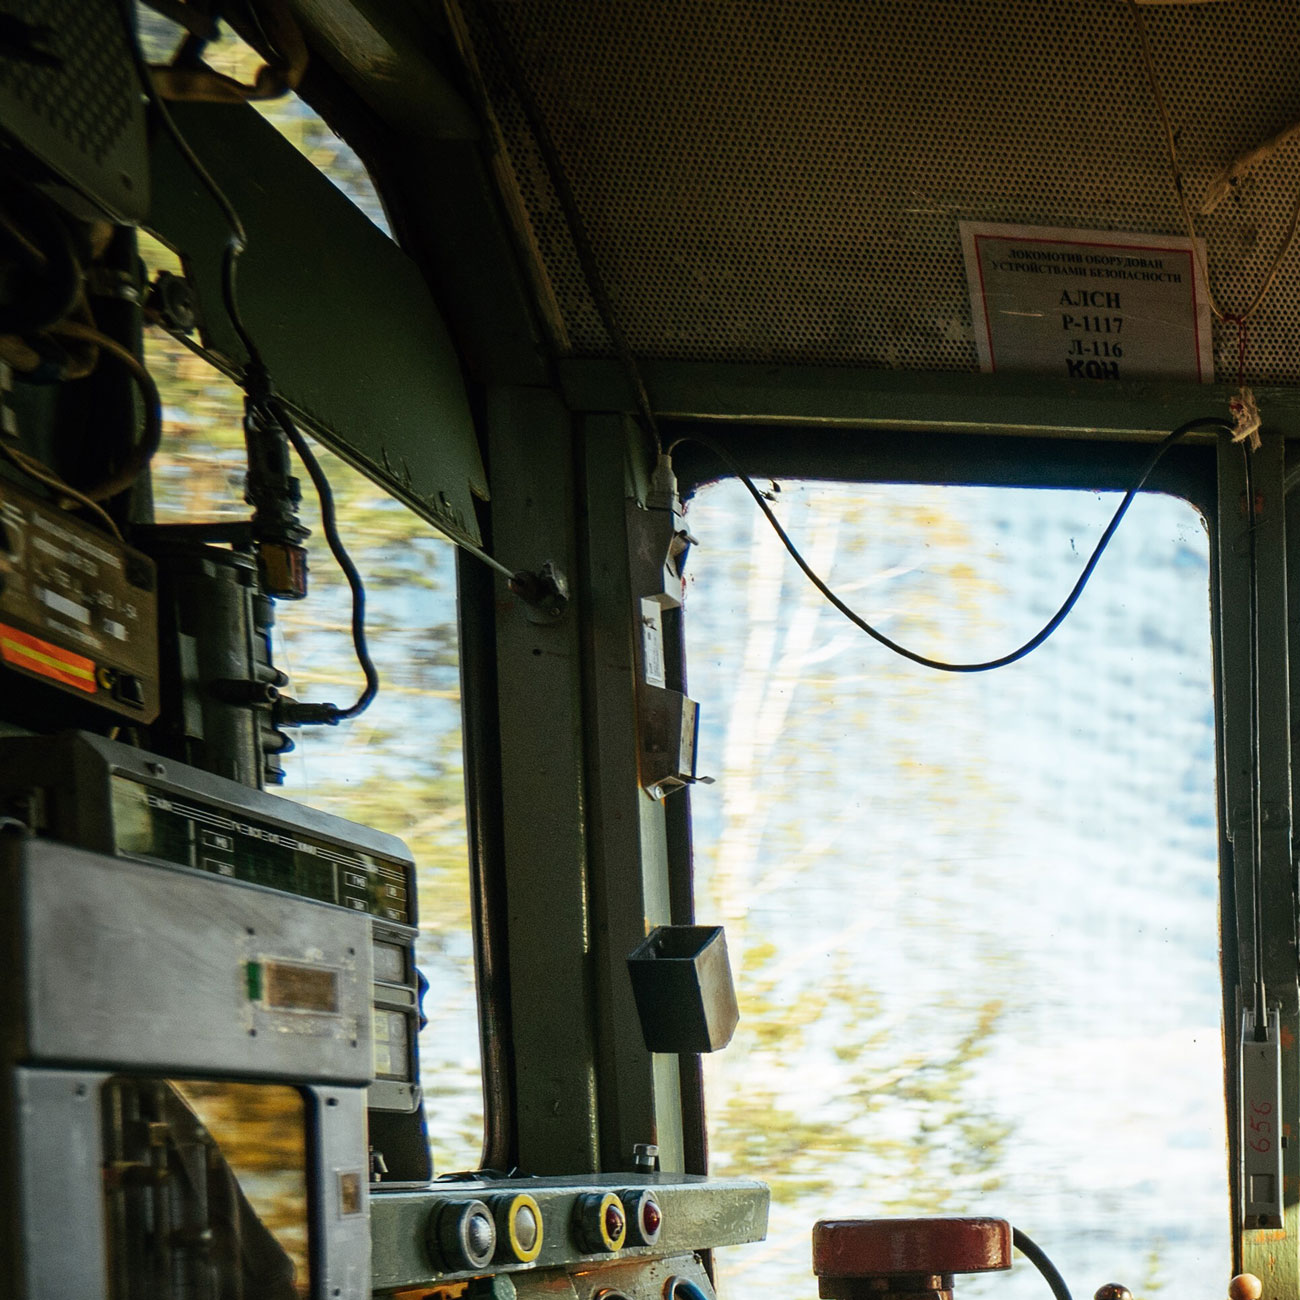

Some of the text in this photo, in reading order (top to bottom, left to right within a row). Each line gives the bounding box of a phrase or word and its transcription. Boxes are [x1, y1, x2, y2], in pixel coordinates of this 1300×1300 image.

[1008, 249, 1163, 269] ЛОКОМОТИВ ОБОРУДОВАН
[990, 260, 1182, 284] УСТРОЙСТВАМИ БЕЗОПАСНОСТИ
[1059, 289, 1121, 309] АЛСН
[1062, 315, 1123, 334] Р-1117
[1068, 340, 1123, 357] Л-116
[1065, 358, 1120, 380] КОН
[1249, 1099, 1272, 1153] 656
